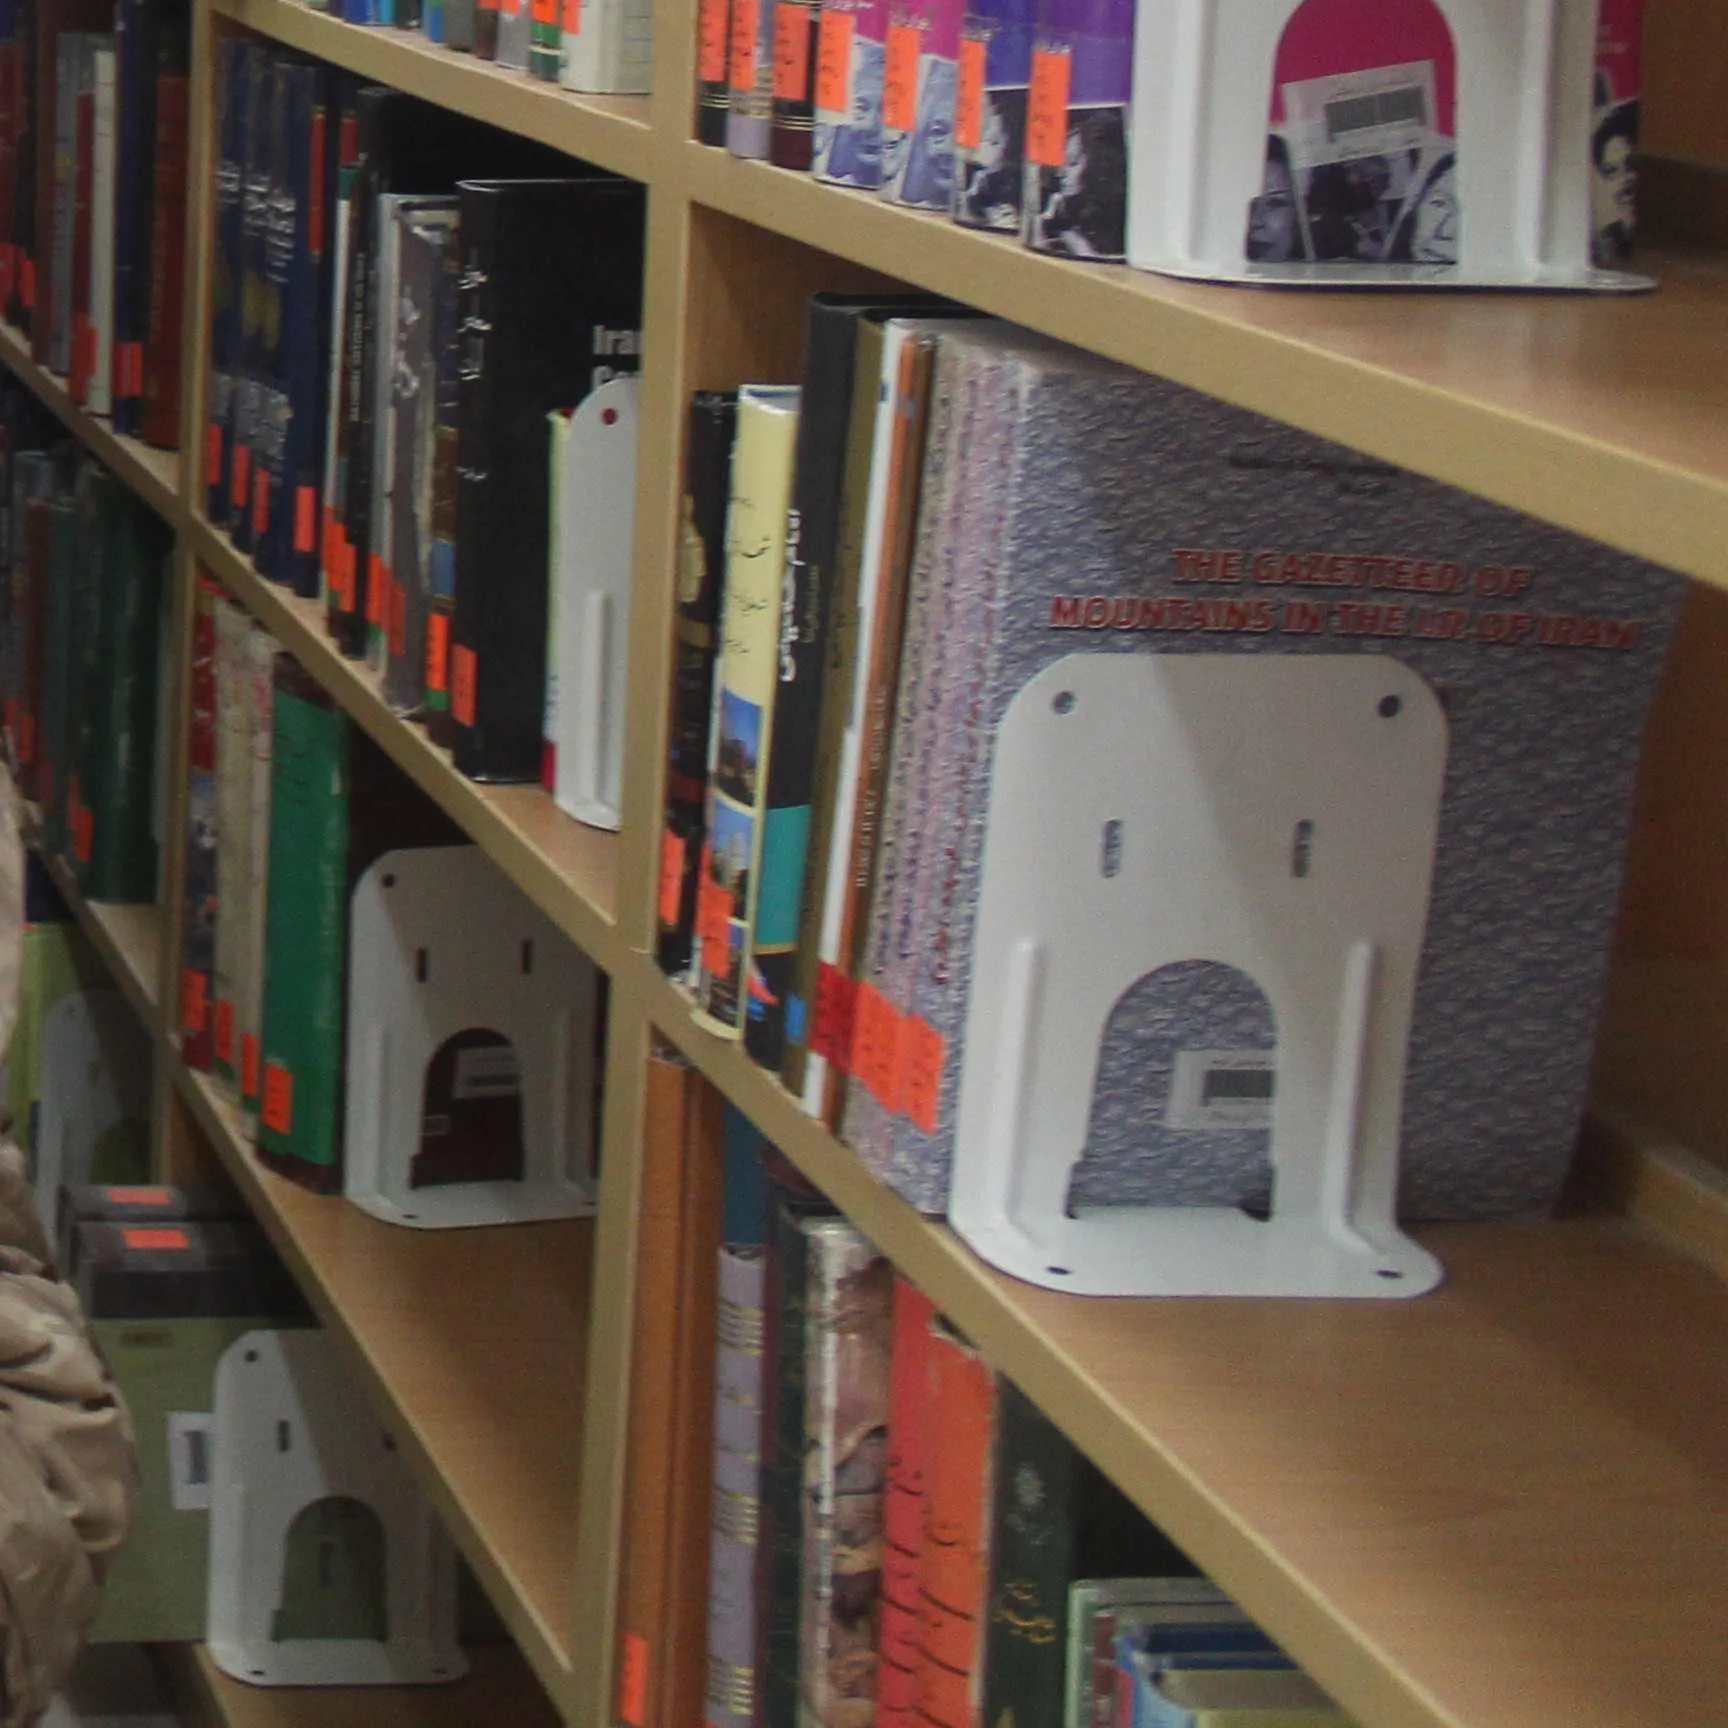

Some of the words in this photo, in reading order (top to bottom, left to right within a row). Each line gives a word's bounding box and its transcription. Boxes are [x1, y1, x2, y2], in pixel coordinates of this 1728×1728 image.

[1171, 547, 1242, 584] THE
[1252, 549, 1458, 594] GAZETTEER
[1474, 563, 1535, 598] OF
[1049, 594, 1272, 633] MOUNTAINS
[1282, 601, 1324, 634] IN
[1334, 602, 1406, 637] THE
[1476, 611, 1533, 644] OF
[1540, 615, 1638, 649] IRAN
